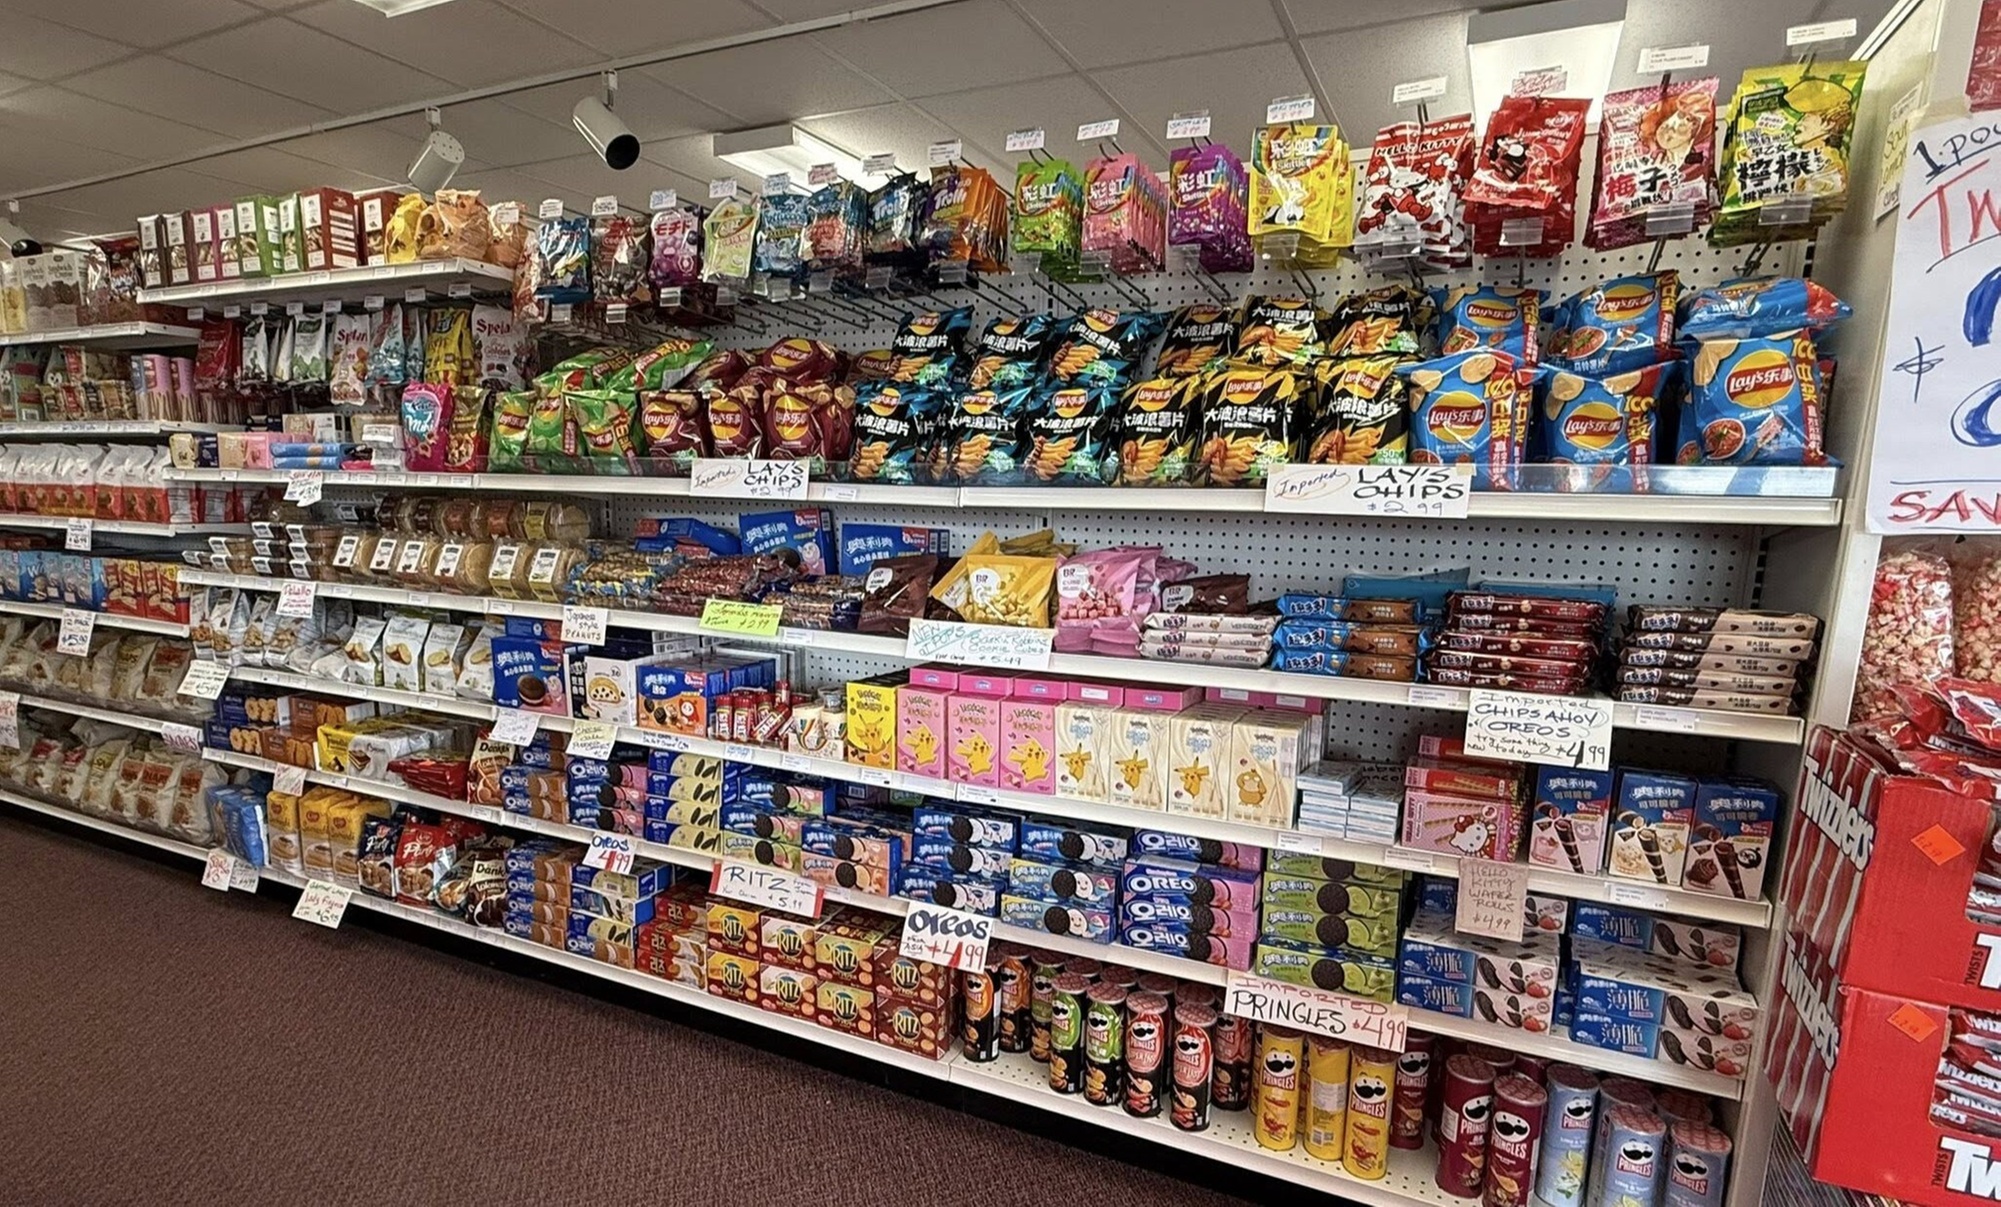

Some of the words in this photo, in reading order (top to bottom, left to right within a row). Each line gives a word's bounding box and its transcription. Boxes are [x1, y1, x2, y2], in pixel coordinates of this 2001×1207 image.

[1420, 136, 1463, 152] KITTY
[1090, 178, 1125, 200] 彩虹
[1176, 170, 1215, 193] 彩虹
[1020, 183, 1057, 202] 彩虹
[1171, 323, 1236, 339] 大波浪薯片
[1728, 367, 1795, 393] Lay's乐事
[854, 412, 911, 437] 大波浪薯片
[1204, 405, 1278, 424] 大波浪薯片
[1429, 408, 1485, 425] Lay's乐事
[1565, 417, 1622, 435] Lay's乐事
[747, 459, 804, 476] LAY'S
[1357, 466, 1451, 485] LAY'S
[743, 474, 803, 489] CHIPS
[1275, 467, 1348, 498] Imported
[1353, 483, 1465, 500] CHIPS
[565, 628, 602, 641] PEANUTS
[1479, 691, 1602, 711] Imported
[1474, 703, 1541, 719] CHIPS
[1544, 709, 1599, 727] AHOY
[1487, 720, 1571, 738] OREOS
[1466, 742, 1487, 752] new
[1800, 753, 1876, 873] Twizzlers
[591, 834, 630, 851] Oreos
[1140, 832, 1200, 852] 오레오
[723, 865, 791, 894] RITZ
[1470, 863, 1509, 878] HELLO
[1129, 875, 1198, 893] OREO
[1471, 873, 1517, 890] KITTY
[1468, 888, 1516, 901] WAFER
[1130, 900, 1194, 923] 오레오
[1472, 898, 1515, 914] ROLLS
[722, 917, 745, 937] RITZ
[907, 909, 990, 941] Oreos
[776, 932, 802, 954] RITZ
[1128, 927, 1191, 948] 오레오
[832, 947, 858, 972] RITZ
[1964, 948, 1985, 985] TWISTS
[721, 965, 746, 985] RITZ
[890, 964, 921, 987] RITZ
[775, 980, 802, 1002] RITZ
[1234, 976, 1389, 1017] IMPORTED
[1779, 928, 1840, 1073] Twizzlers
[831, 996, 859, 1020] RITZ
[1232, 989, 1348, 1036] PRINGLES
[892, 1012, 922, 1035] RITZ
[1130, 1038, 1158, 1052] PRINGLES
[1262, 1070, 1296, 1090] PRINGLES
[1396, 1073, 1429, 1088] PRINGLES
[1350, 1096, 1386, 1119] PRINGLES
[1617, 1157, 1653, 1177] PRINGLES
[1931, 1151, 1950, 1187] TWISTS
[1671, 1171, 1709, 1195] PRINGLES
